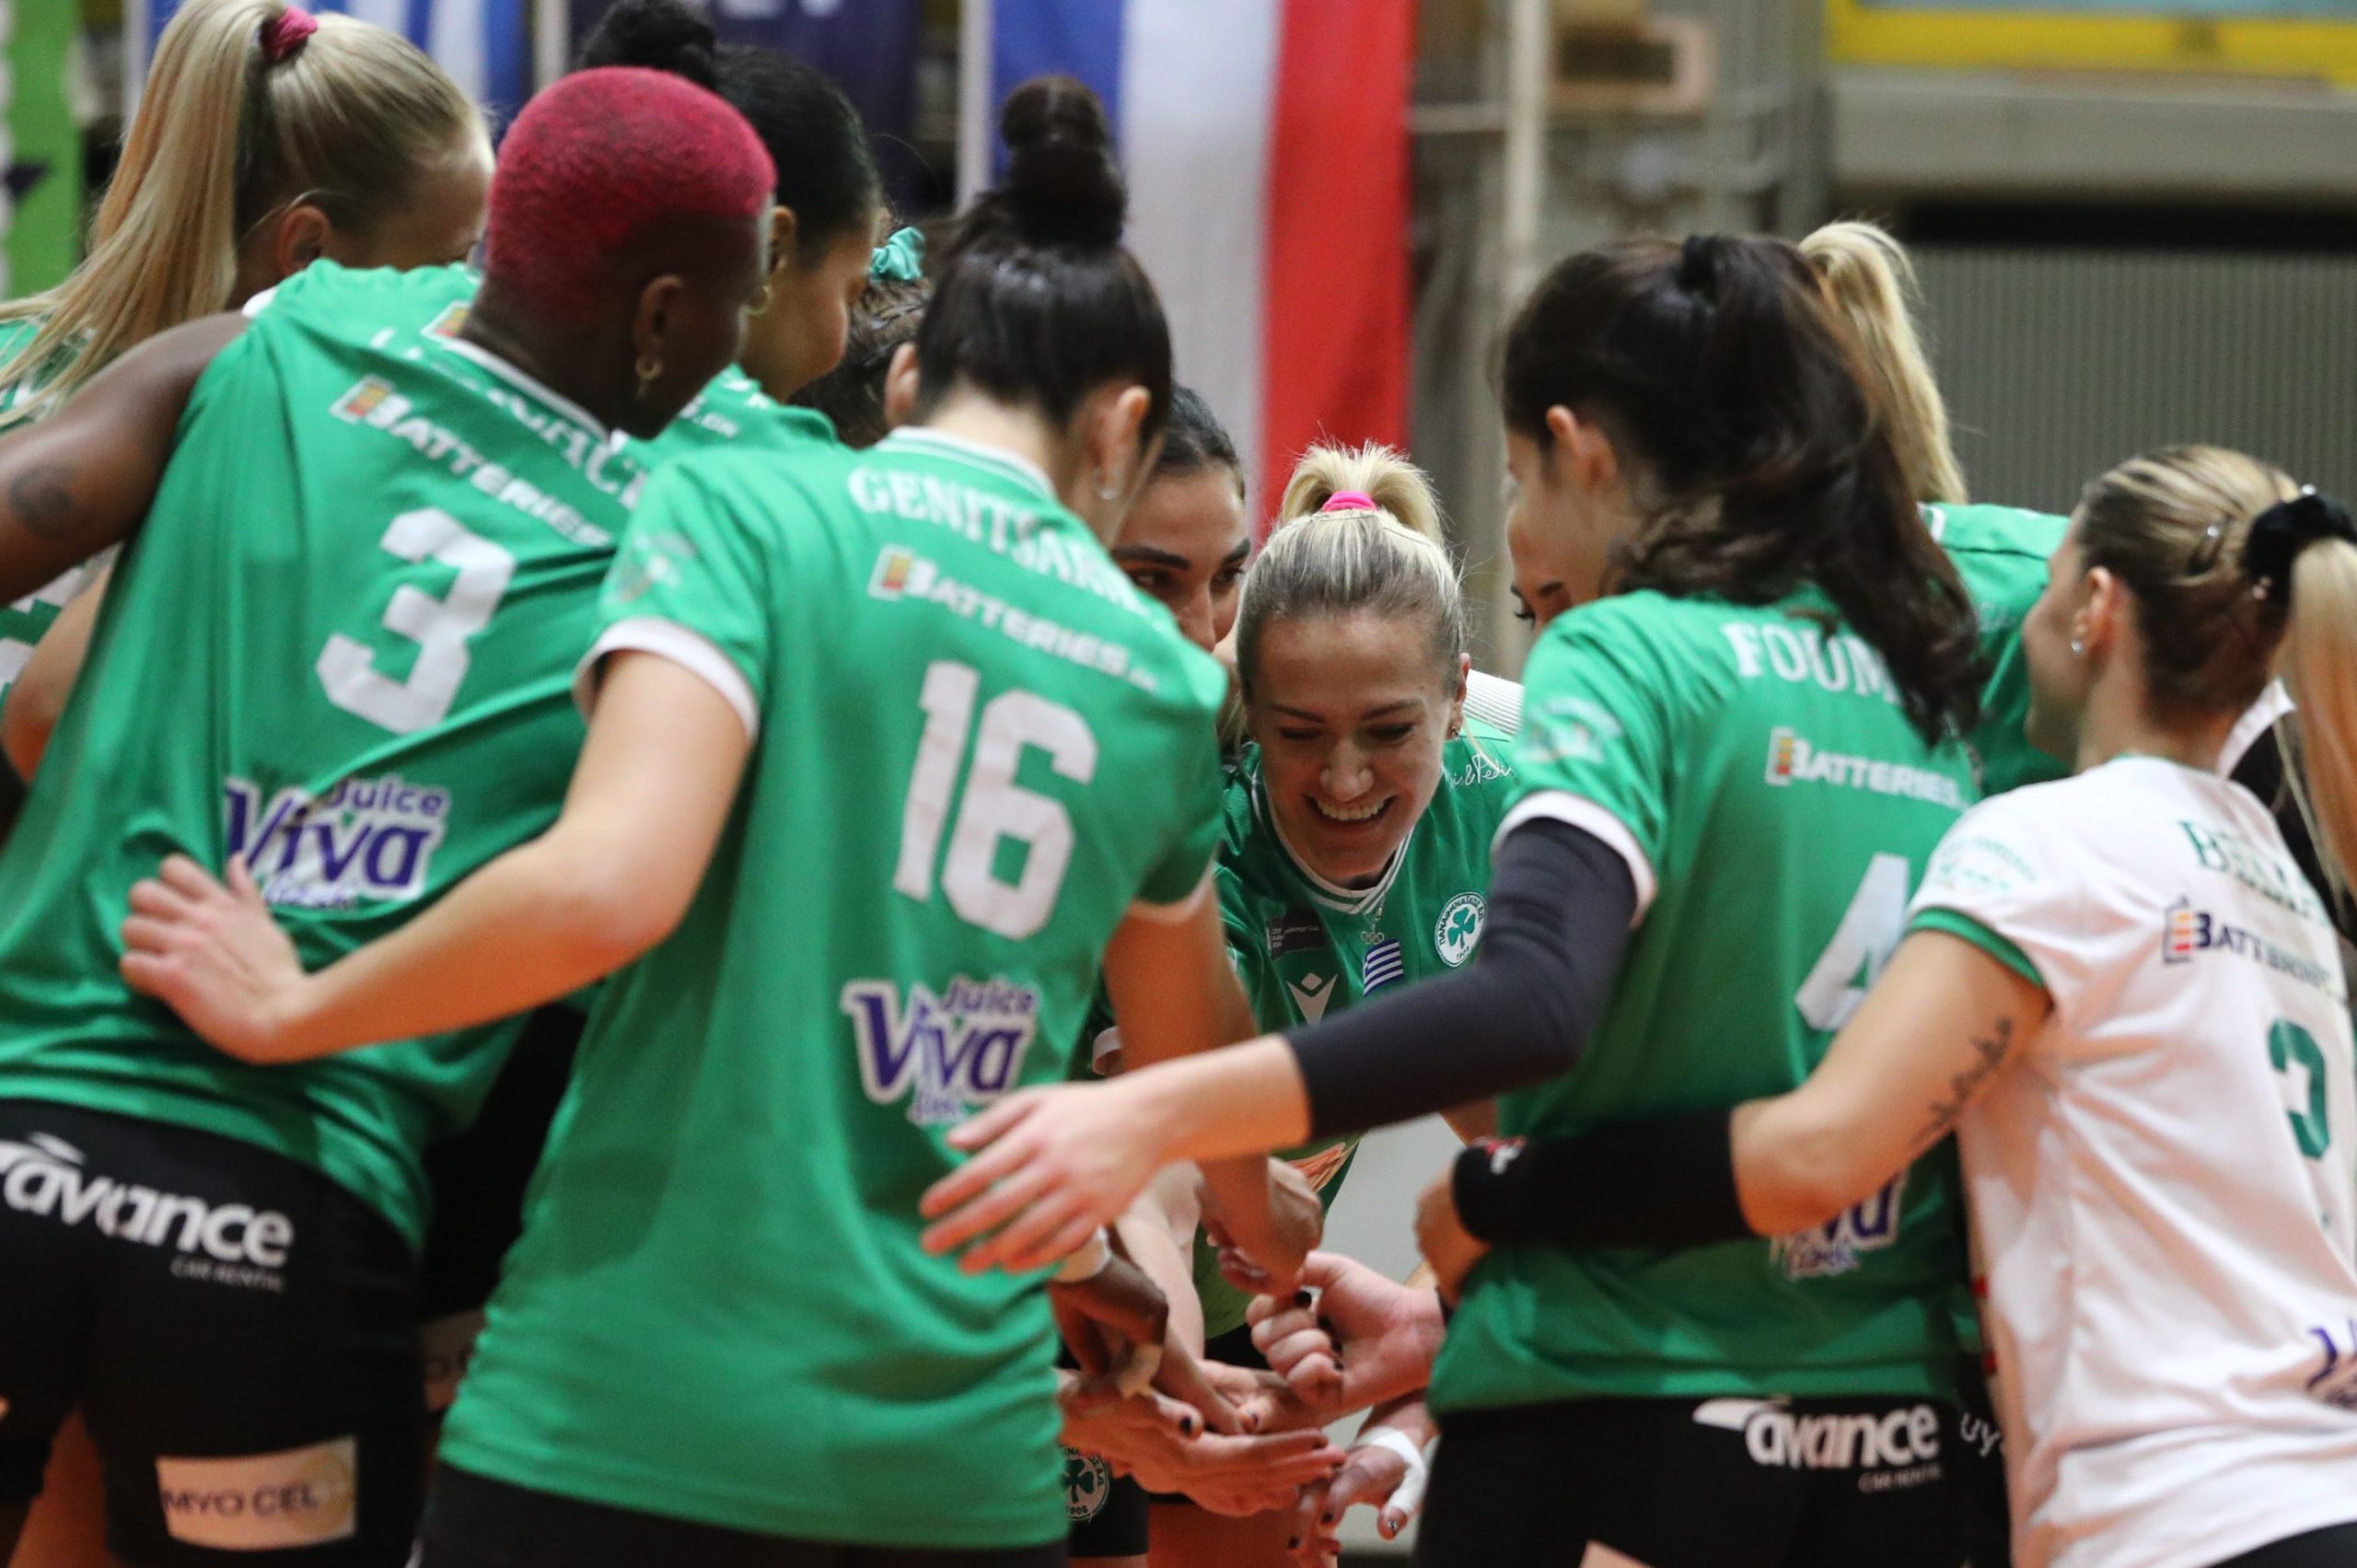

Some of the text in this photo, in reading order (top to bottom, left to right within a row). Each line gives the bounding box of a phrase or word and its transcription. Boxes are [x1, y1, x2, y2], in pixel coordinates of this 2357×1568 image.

[316, 507, 517, 735] 3
[1719, 621, 1902, 705] FOUM
[226, 786, 431, 889] Viva
[893, 659, 1099, 942] 16
[1794, 852, 1910, 1031] 4
[4, 1160, 294, 1268] avance
[1746, 1403, 1939, 1469] avance
